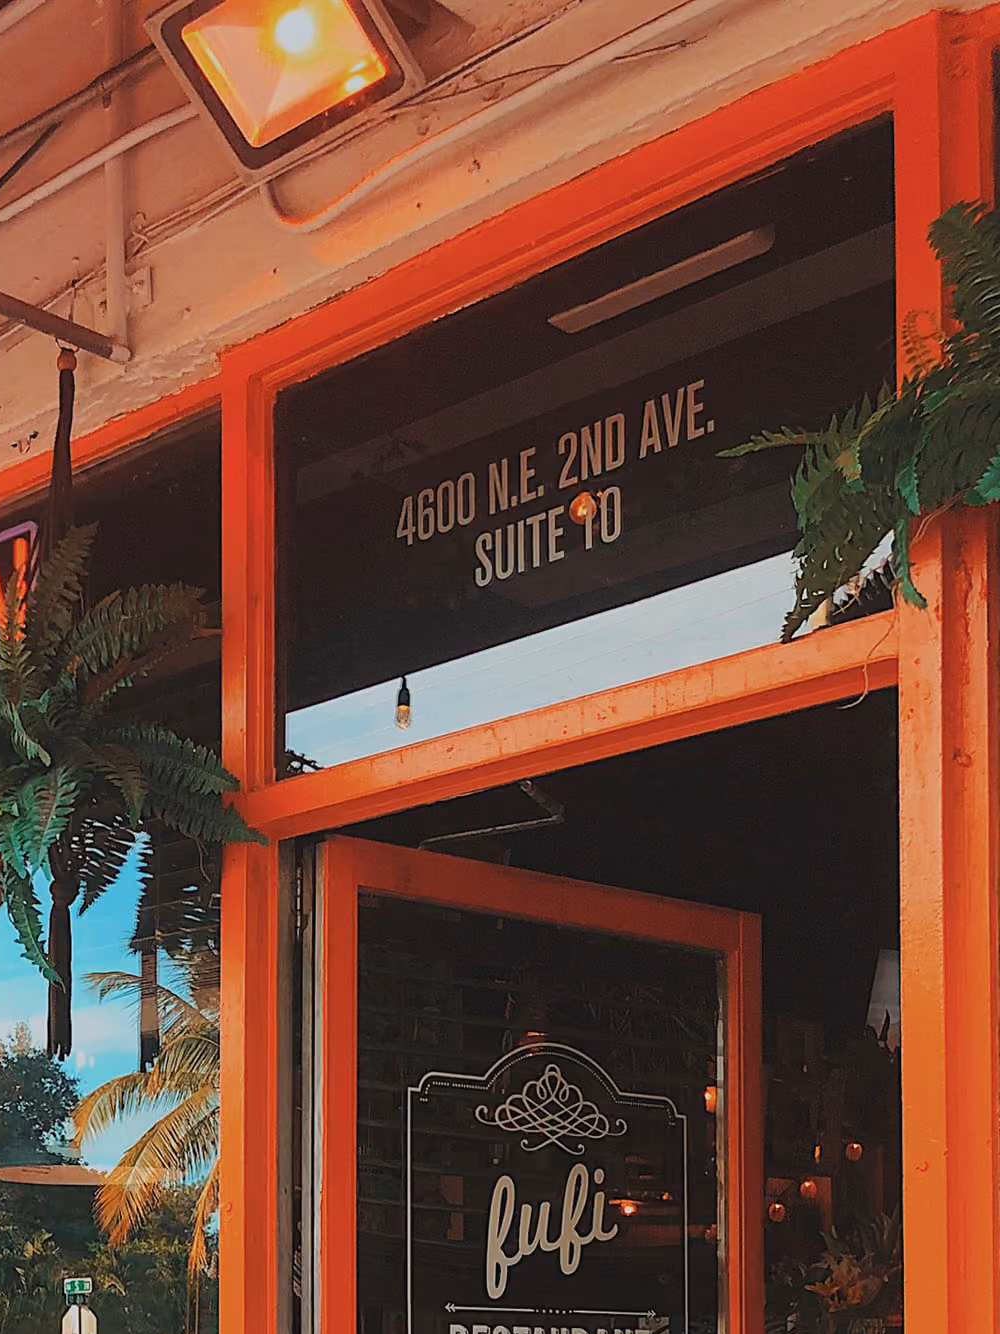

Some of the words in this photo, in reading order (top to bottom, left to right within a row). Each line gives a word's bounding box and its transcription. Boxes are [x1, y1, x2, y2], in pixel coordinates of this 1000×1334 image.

[396, 472, 475, 545] 4600
[489, 447, 544, 514] N.E.
[558, 412, 626, 489] 2ND
[639, 379, 715, 459] AVE.
[474, 505, 565, 587] SUITE
[584, 486, 621, 549] 10
[486, 1163, 618, 1299] fufi
